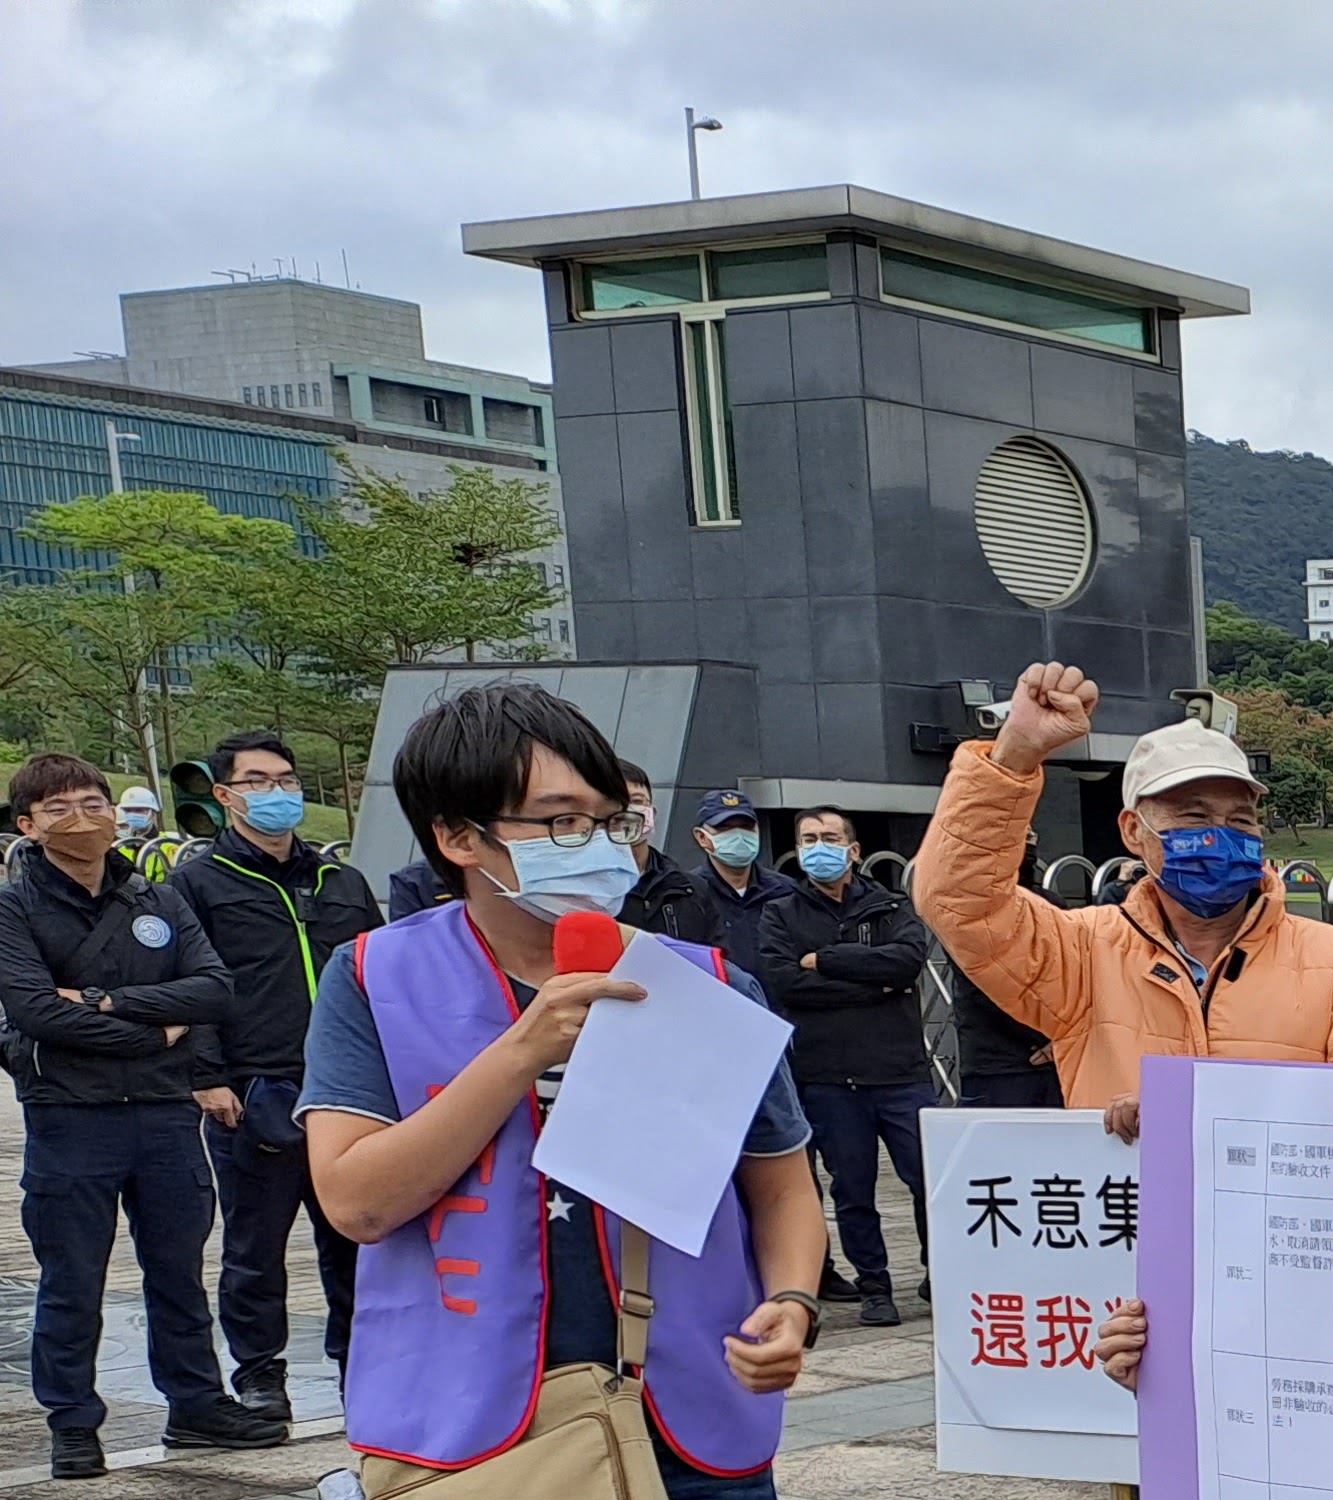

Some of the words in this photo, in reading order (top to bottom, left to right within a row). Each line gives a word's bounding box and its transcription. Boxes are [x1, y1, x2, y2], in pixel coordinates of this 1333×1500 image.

[966, 1173, 1139, 1252] 禾意集
[971, 1292, 1122, 1370] 還我
